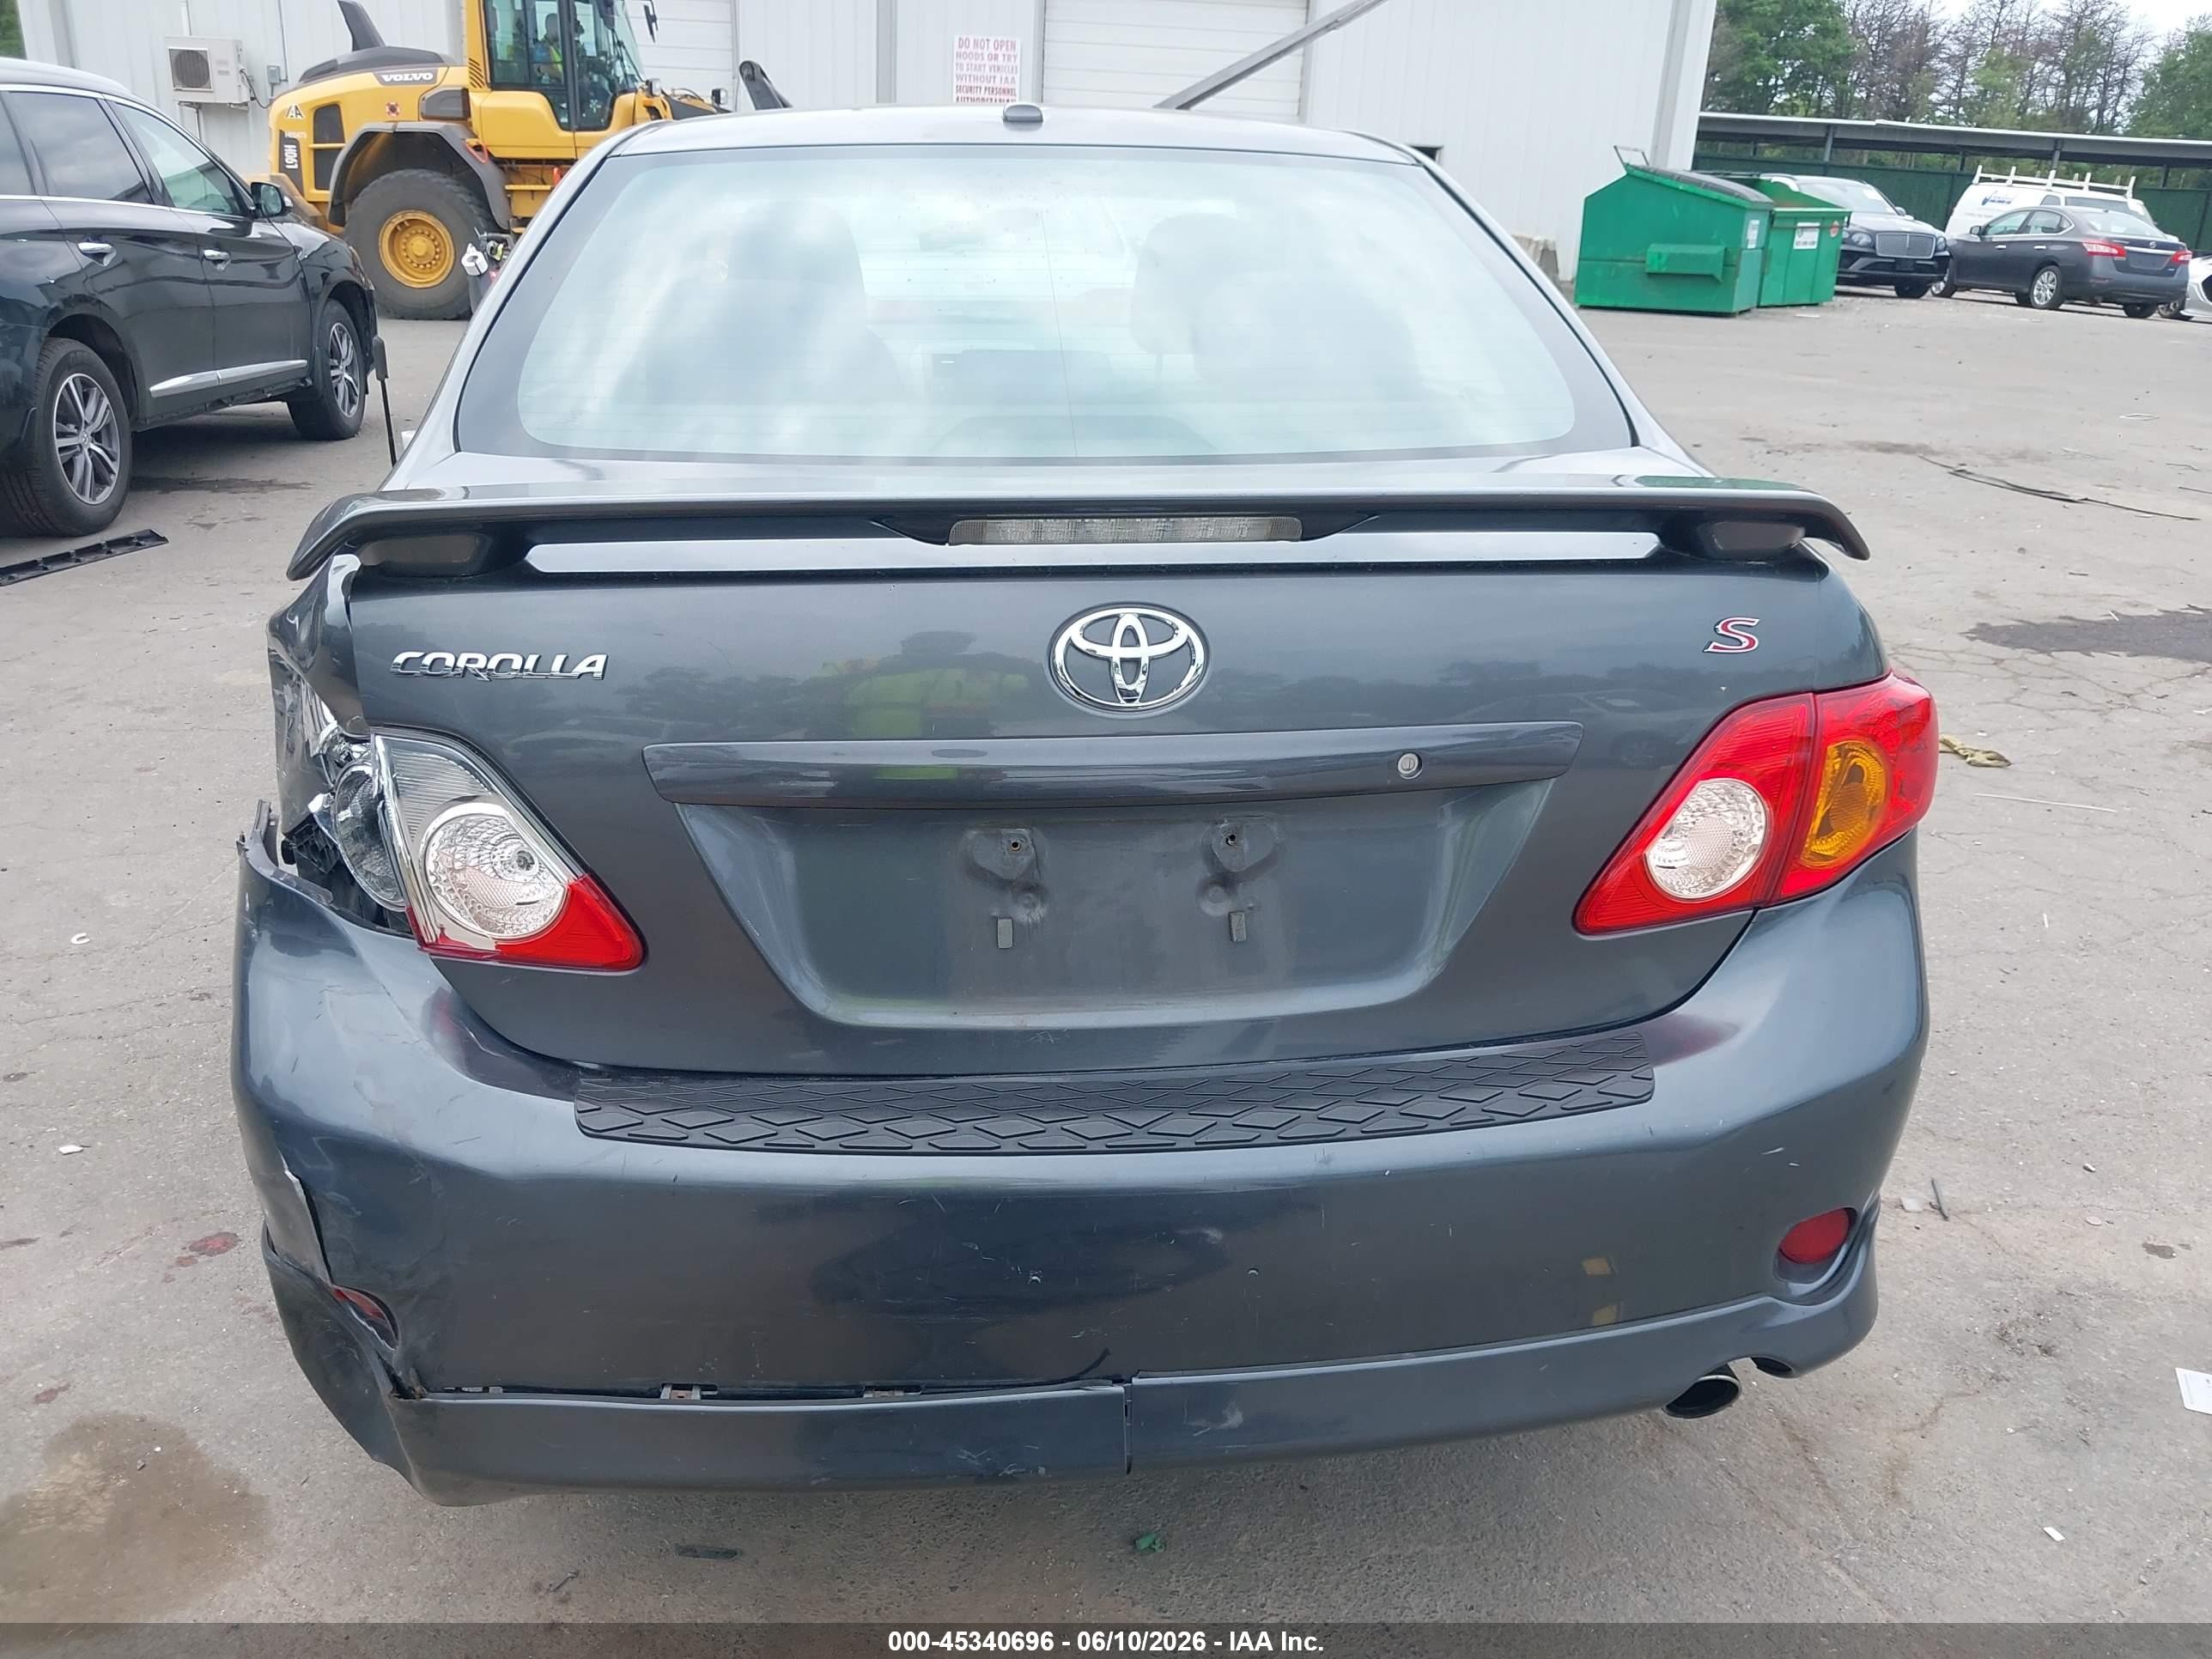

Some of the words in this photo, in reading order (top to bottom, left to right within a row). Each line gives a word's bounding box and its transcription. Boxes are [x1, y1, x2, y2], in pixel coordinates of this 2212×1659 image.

[958, 37, 970, 50] DO
[973, 38, 991, 51] NOT
[994, 39, 1017, 52] OPEN
[956, 51, 984, 61] HOODS
[988, 52, 999, 63] OR
[1002, 53, 1018, 63] TRY
[956, 63, 963, 71] TO
[966, 63, 986, 73] START
[988, 64, 1018, 75] VEHICLES
[381, 72, 434, 82] VOLVO
[956, 74, 996, 84] WITHOUT
[1000, 76, 1017, 84] IAA
[956, 84, 981, 95] SECURITY
[984, 86, 1017, 97] PERSONNEL
[284, 144, 299, 169] L90H
[1702, 616, 1760, 654] S
[390, 651, 609, 682] COROLLA
